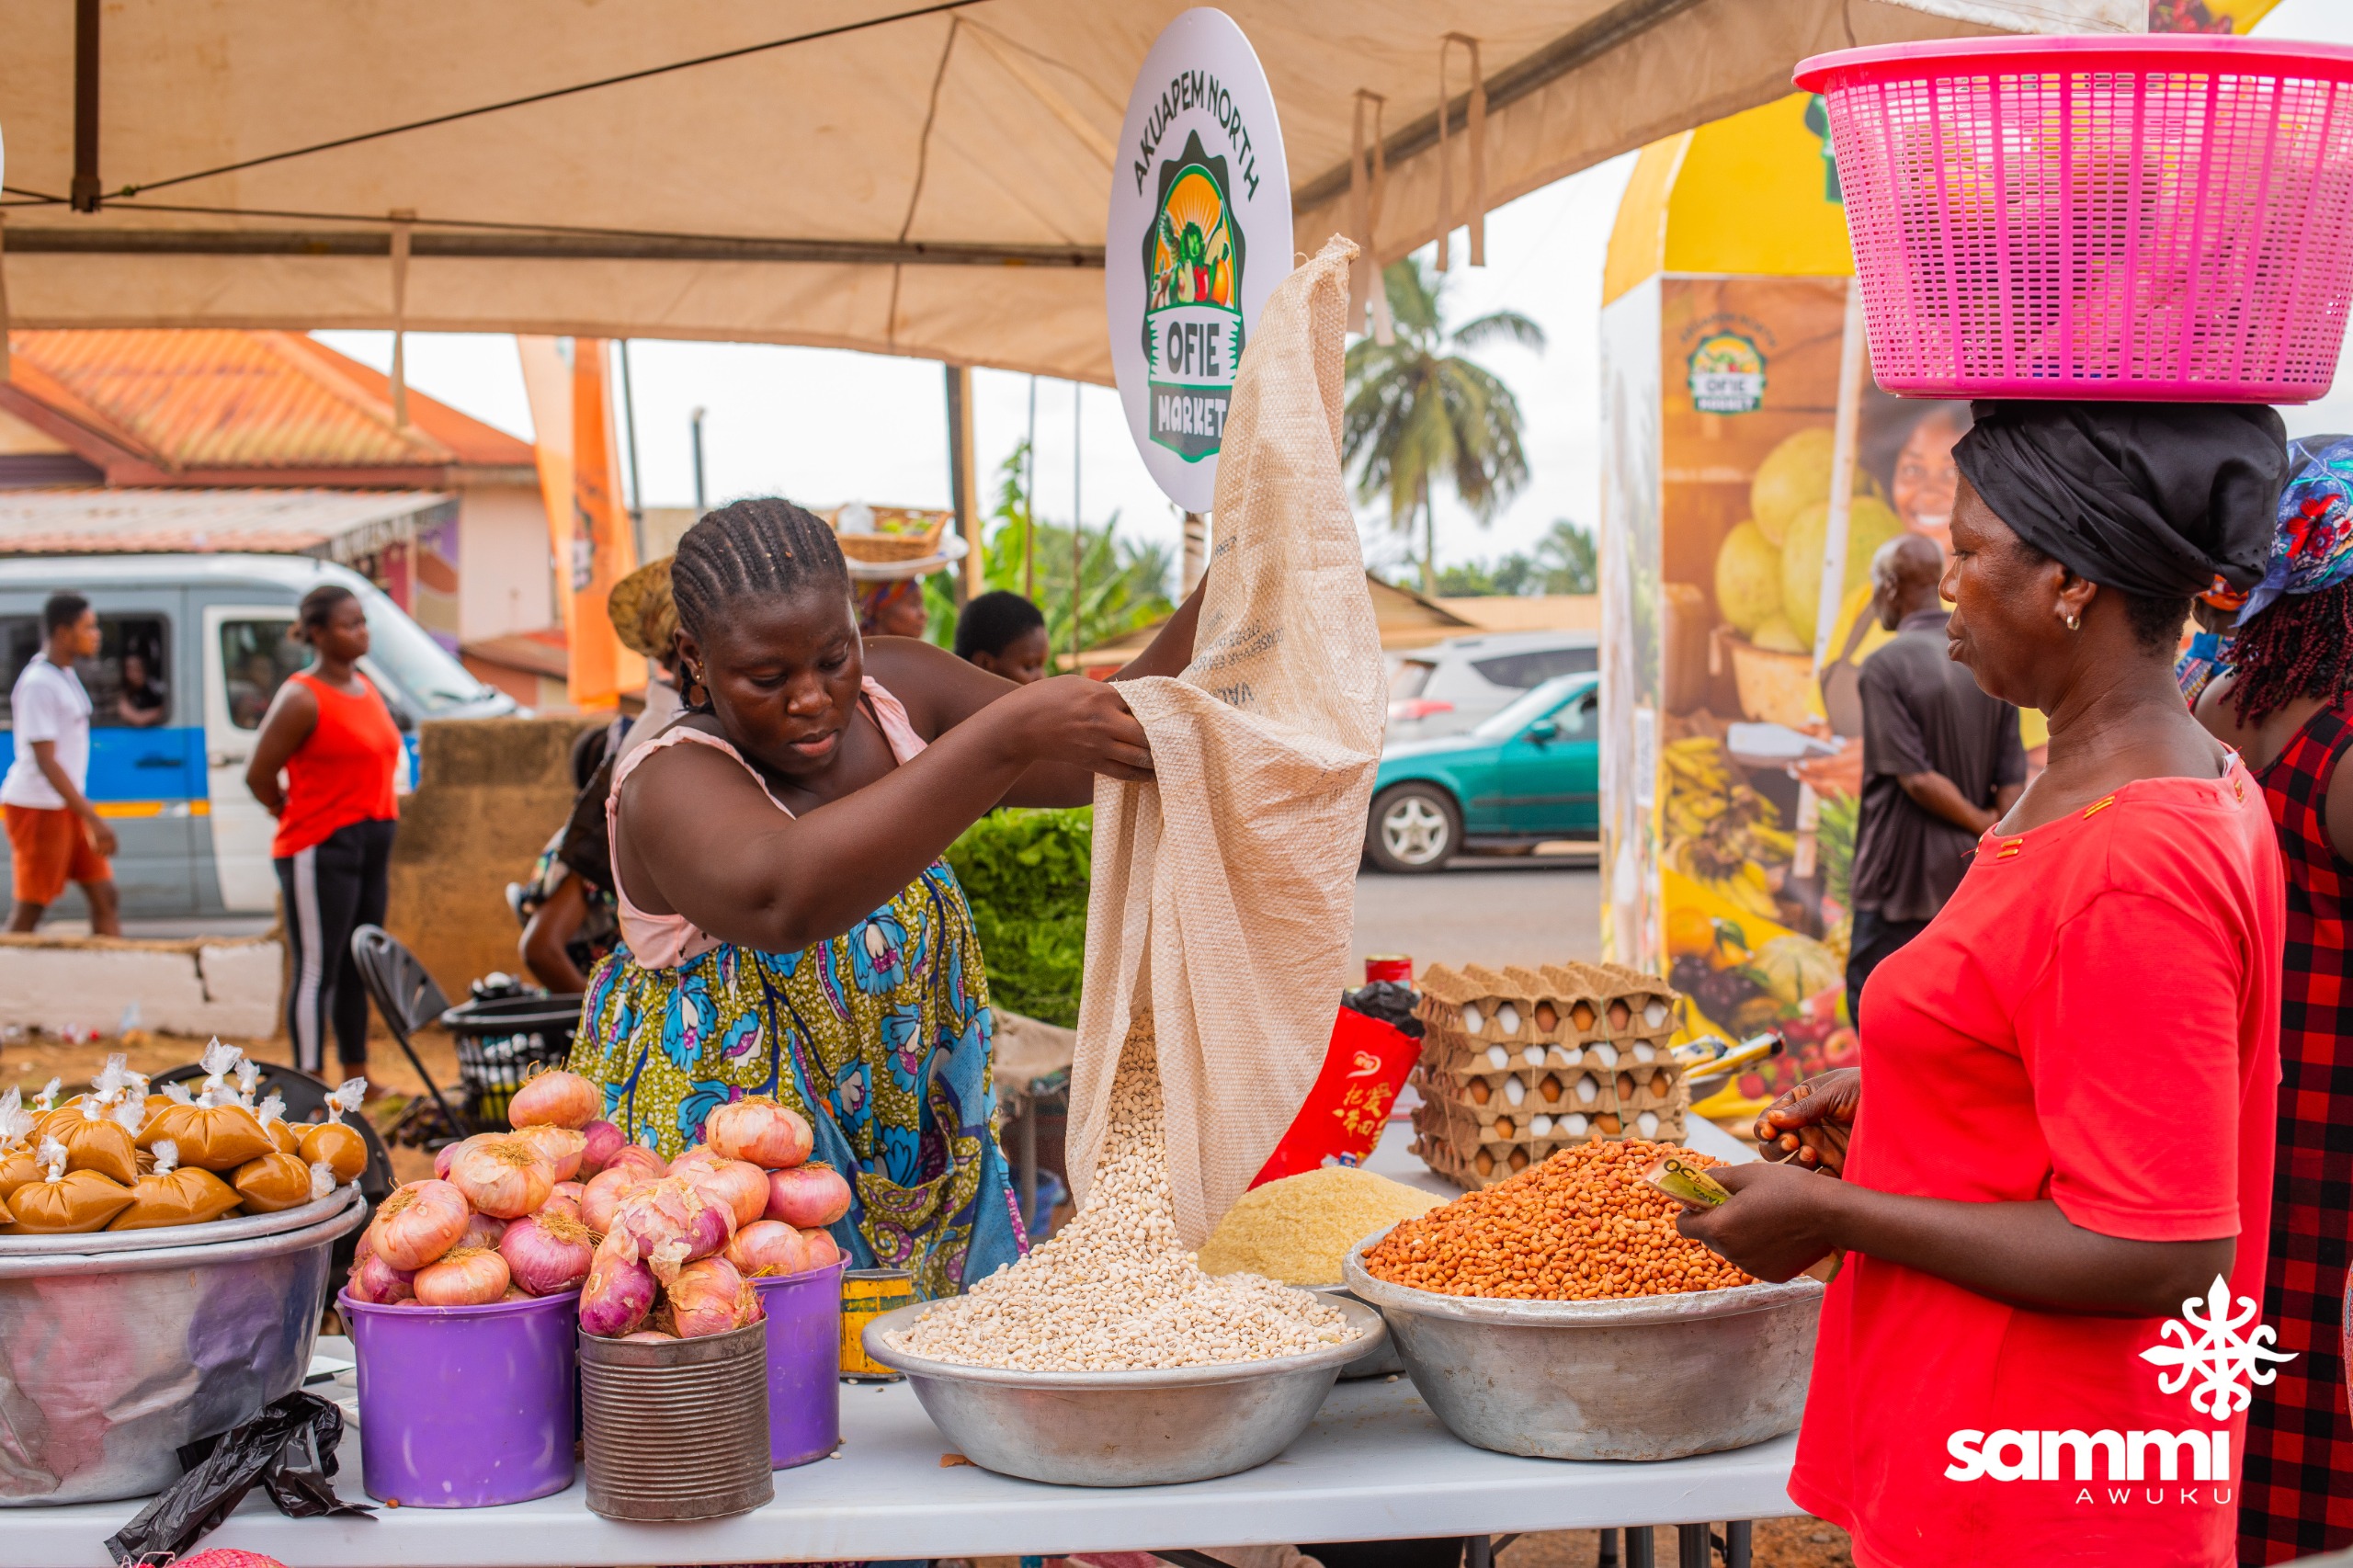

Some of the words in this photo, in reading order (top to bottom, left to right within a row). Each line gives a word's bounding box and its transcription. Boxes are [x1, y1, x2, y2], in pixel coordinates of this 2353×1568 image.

[1134, 69, 1204, 198] AKUAPEM
[1207, 74, 1259, 203] NORTH
[1166, 321, 1220, 377] OFIE
[1158, 394, 1227, 438] MARKET
